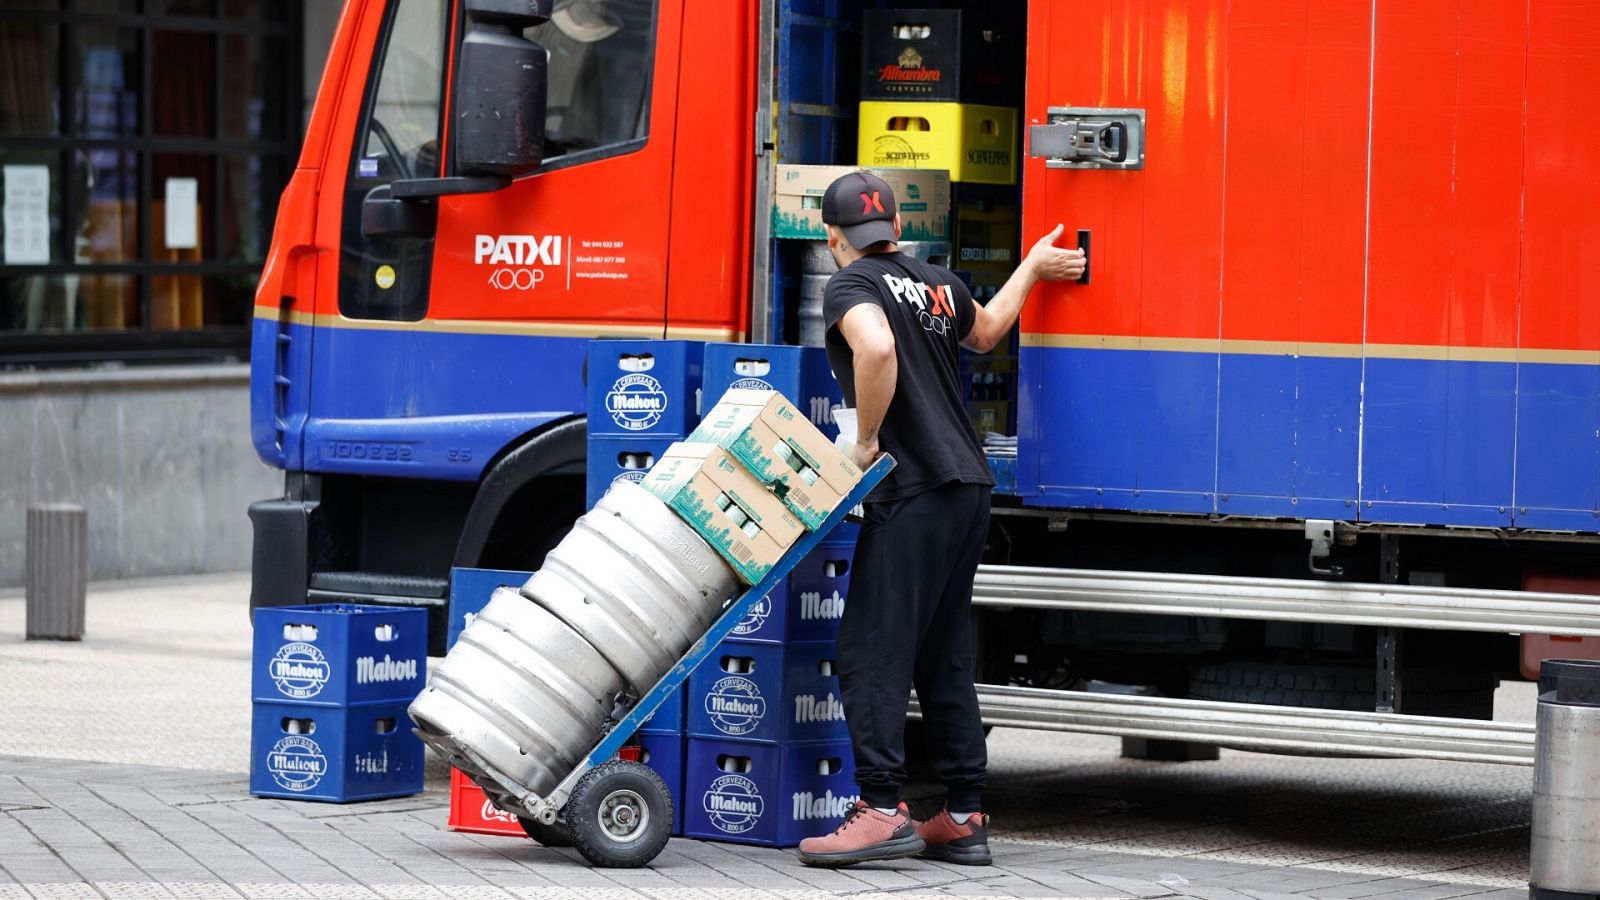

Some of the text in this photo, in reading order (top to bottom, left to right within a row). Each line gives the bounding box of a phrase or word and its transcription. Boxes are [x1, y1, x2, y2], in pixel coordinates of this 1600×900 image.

[878, 64, 942, 82] Alhambra
[885, 151, 930, 161] SCHWEPPES
[967, 150, 1010, 166] SCHWEPPES
[475, 234, 562, 266] PATXI
[488, 268, 545, 290] KOOP
[882, 273, 956, 318] PATXI
[620, 375, 653, 387] CERVEZAS
[734, 380, 769, 390] CERVEZAS
[613, 394, 660, 410] Mahou
[800, 590, 845, 620] Mah
[284, 645, 317, 656] CERVEZAS
[276, 662, 323, 679] Mahou
[356, 654, 418, 685] Mahou
[719, 679, 753, 691] CERVEZAS
[712, 696, 759, 714] Mahou
[717, 776, 751, 789] CERVEZAS
[710, 794, 758, 813] Mahou
